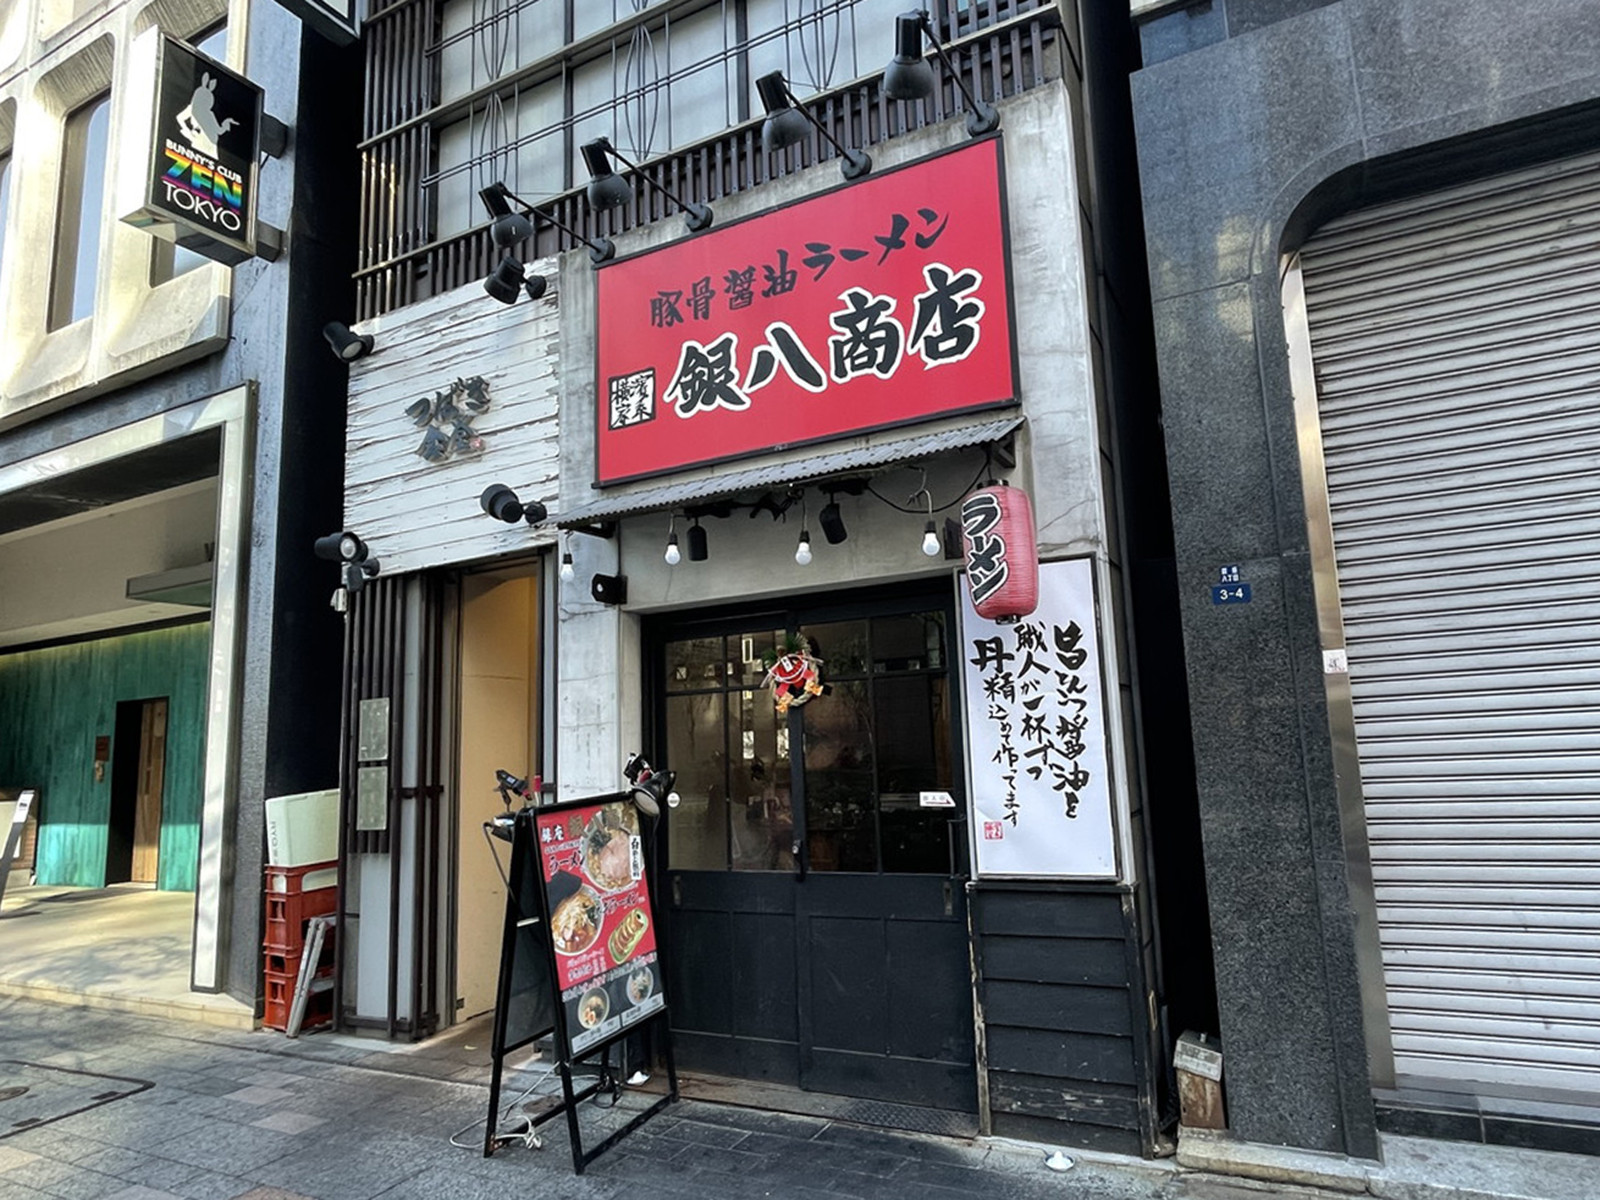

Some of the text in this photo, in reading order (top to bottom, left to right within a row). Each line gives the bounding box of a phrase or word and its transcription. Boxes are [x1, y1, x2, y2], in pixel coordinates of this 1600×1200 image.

[162, 148, 242, 214] ZEN
[163, 180, 241, 231] TOKYO
[166, 138, 242, 184] BUNNY'S CLUB
[651, 208, 949, 328] 豚骨醤油ラーメン
[663, 262, 986, 413] 銀八商店
[962, 493, 1009, 606] ラーメン
[1219, 588, 1244, 601] 3-4
[970, 636, 1021, 828] 丹精込めて作ってます
[1013, 621, 1052, 781] 職人が一杯ずつ
